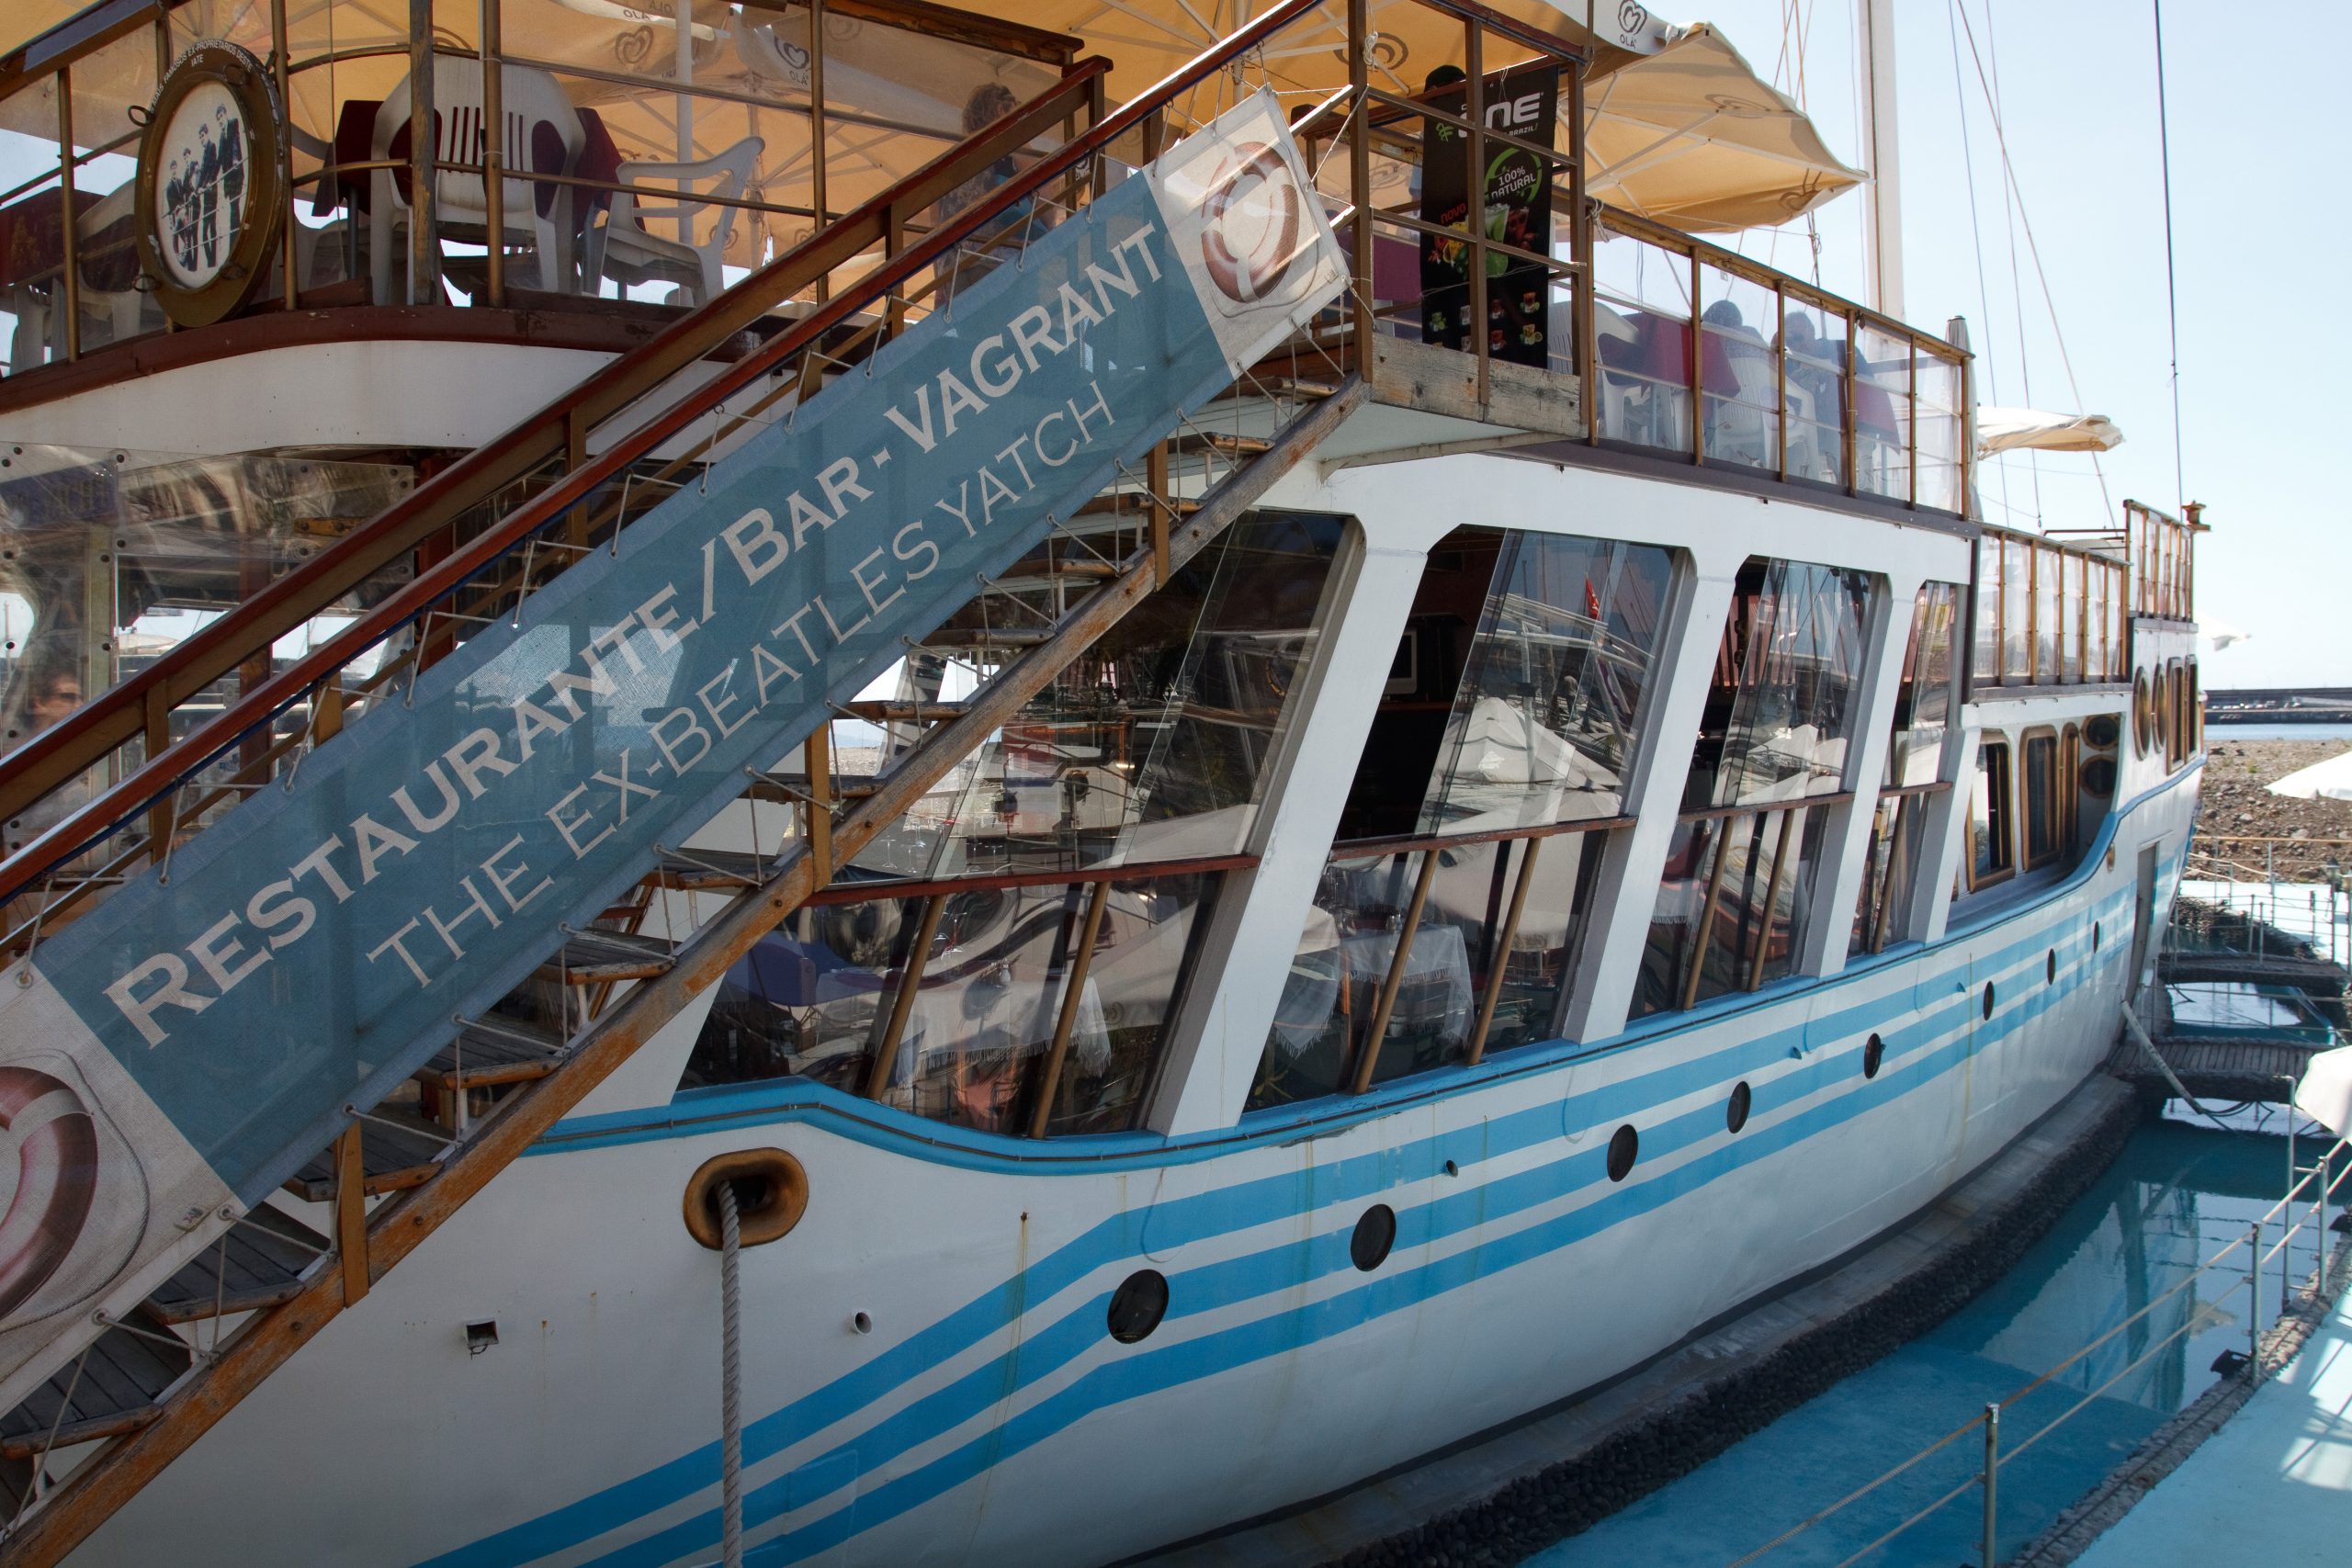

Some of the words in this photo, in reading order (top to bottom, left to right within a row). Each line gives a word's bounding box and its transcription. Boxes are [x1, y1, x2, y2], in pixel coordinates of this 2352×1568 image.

[191, 54, 204, 67] IATE
[236, 51, 253, 73] DESTE
[1498, 165, 1526, 186] 100%
[883, 220, 1162, 454] VAGRANT
[366, 832, 555, 988] THE
[544, 519, 940, 861] EX-BEATLES
[934, 379, 1116, 538] YATCH
